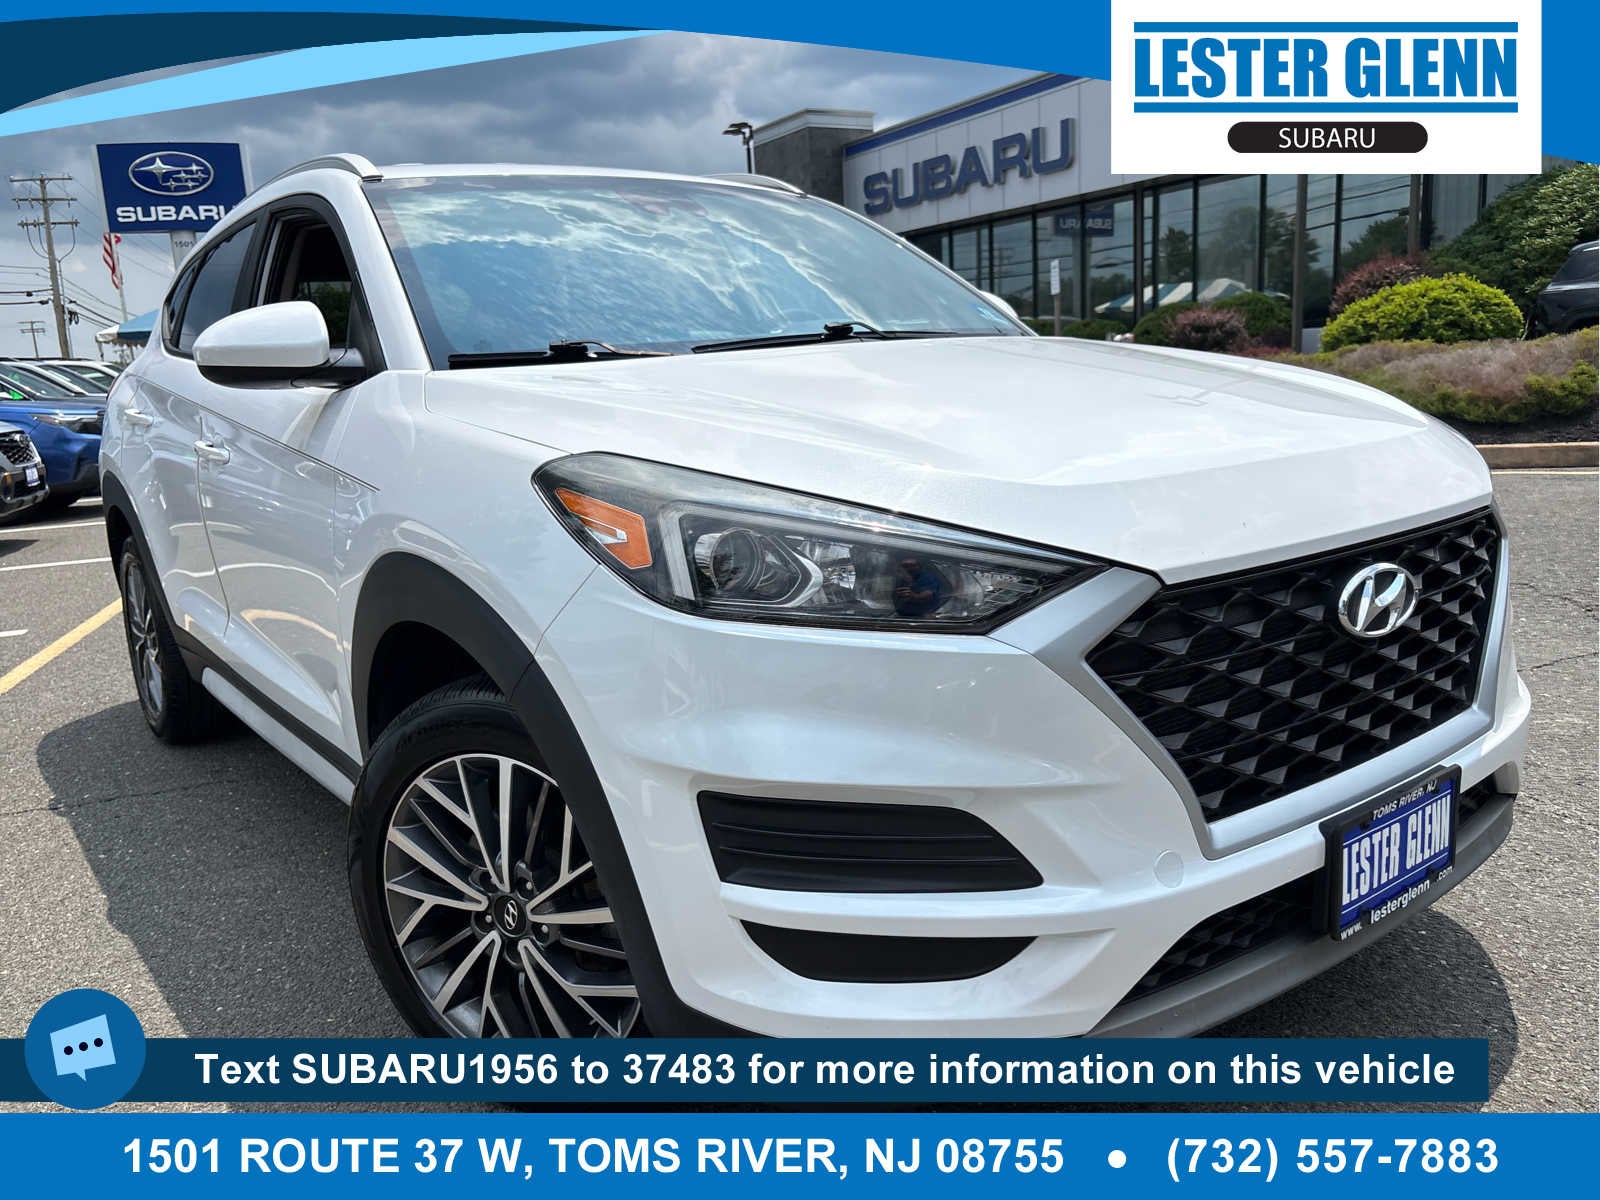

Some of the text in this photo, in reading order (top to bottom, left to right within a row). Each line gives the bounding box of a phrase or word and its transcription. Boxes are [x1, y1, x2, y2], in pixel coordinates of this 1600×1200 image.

[863, 117, 1075, 216] SUBARU
[1372, 800, 1397, 820] TOMS
[1427, 780, 1438, 793] NJ
[1341, 794, 1451, 906] LESTER GLENN
[1370, 878, 1431, 924] lesterglenn
